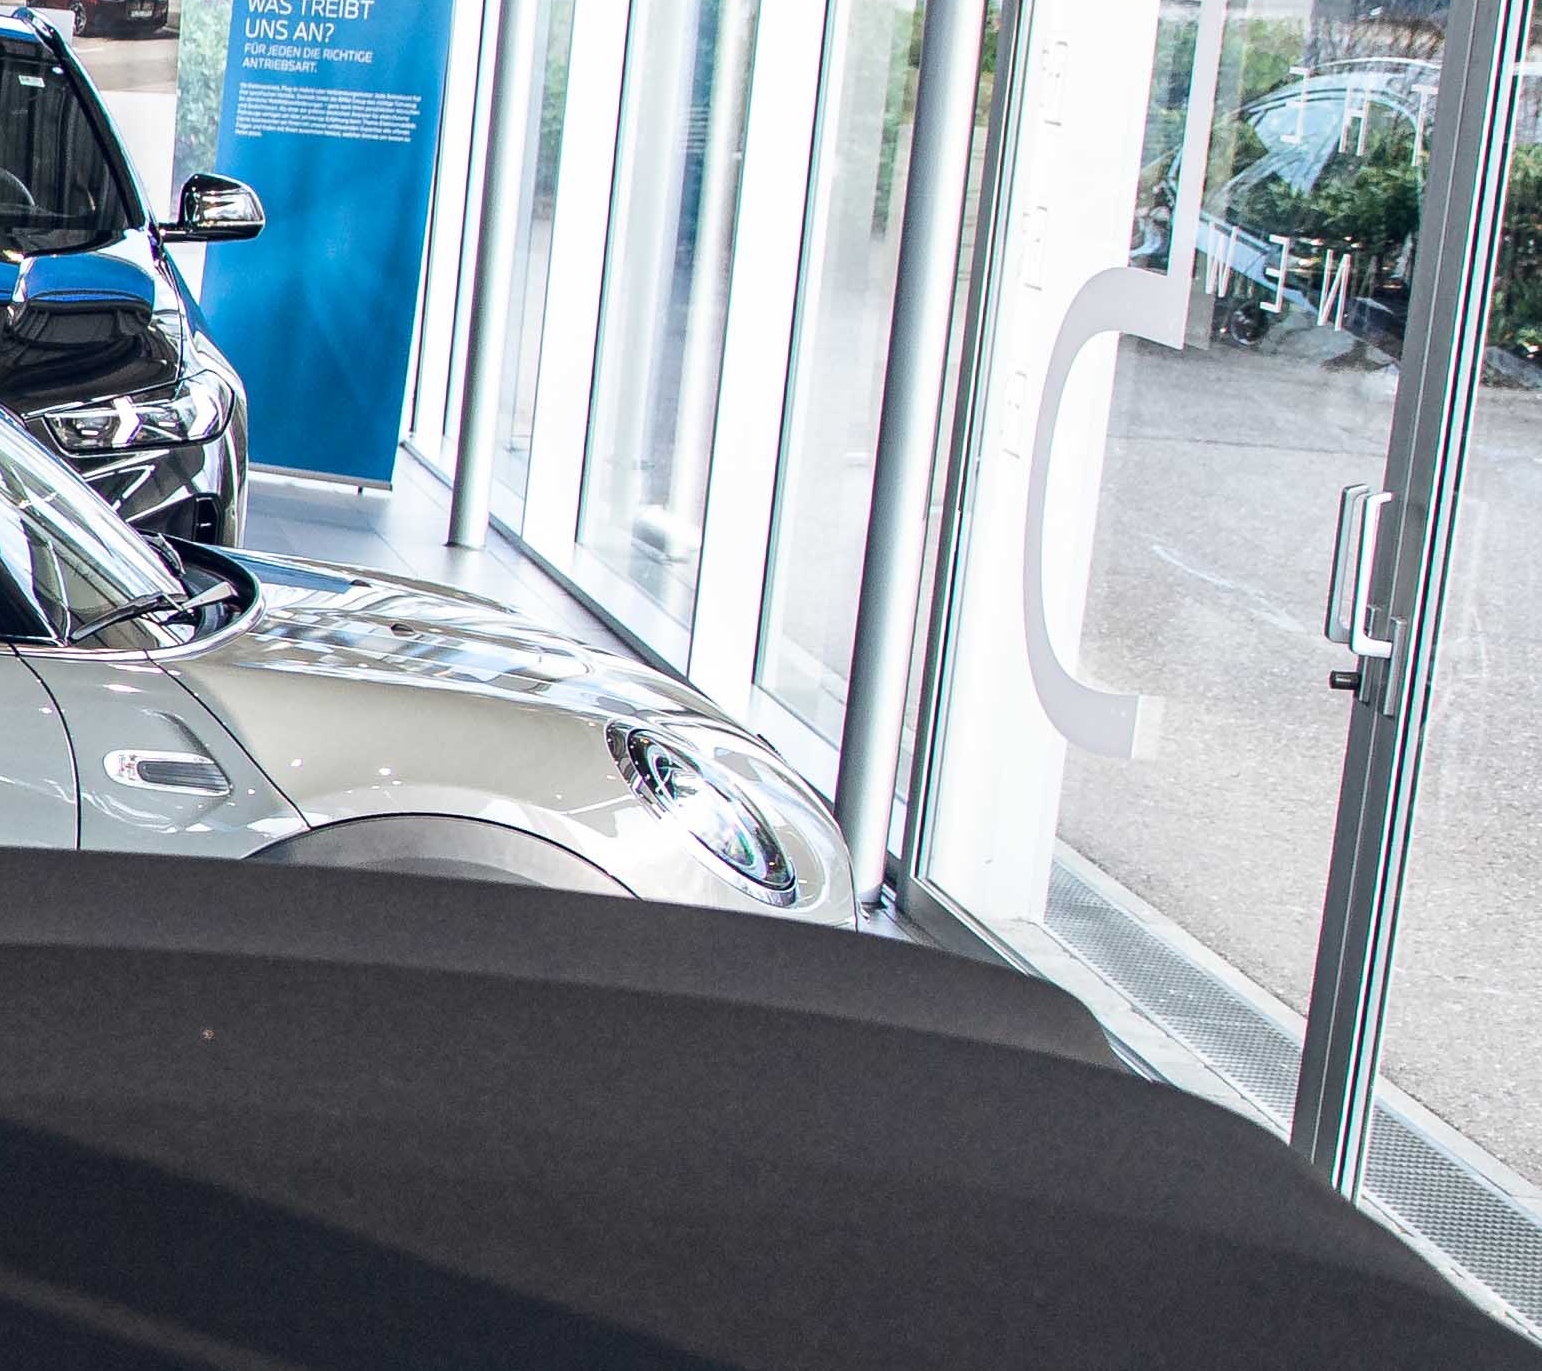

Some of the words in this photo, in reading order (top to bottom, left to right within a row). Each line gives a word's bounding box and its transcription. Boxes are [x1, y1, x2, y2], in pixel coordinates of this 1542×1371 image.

[244, 18, 288, 41] UNS
[292, 21, 335, 43] AN?
[244, 42, 266, 56] FÜR
[267, 44, 301, 59] JEDEN
[302, 46, 321, 60] DIE
[322, 48, 374, 64] RICHTIGE
[242, 57, 318, 74] ANTRIEBSART.
